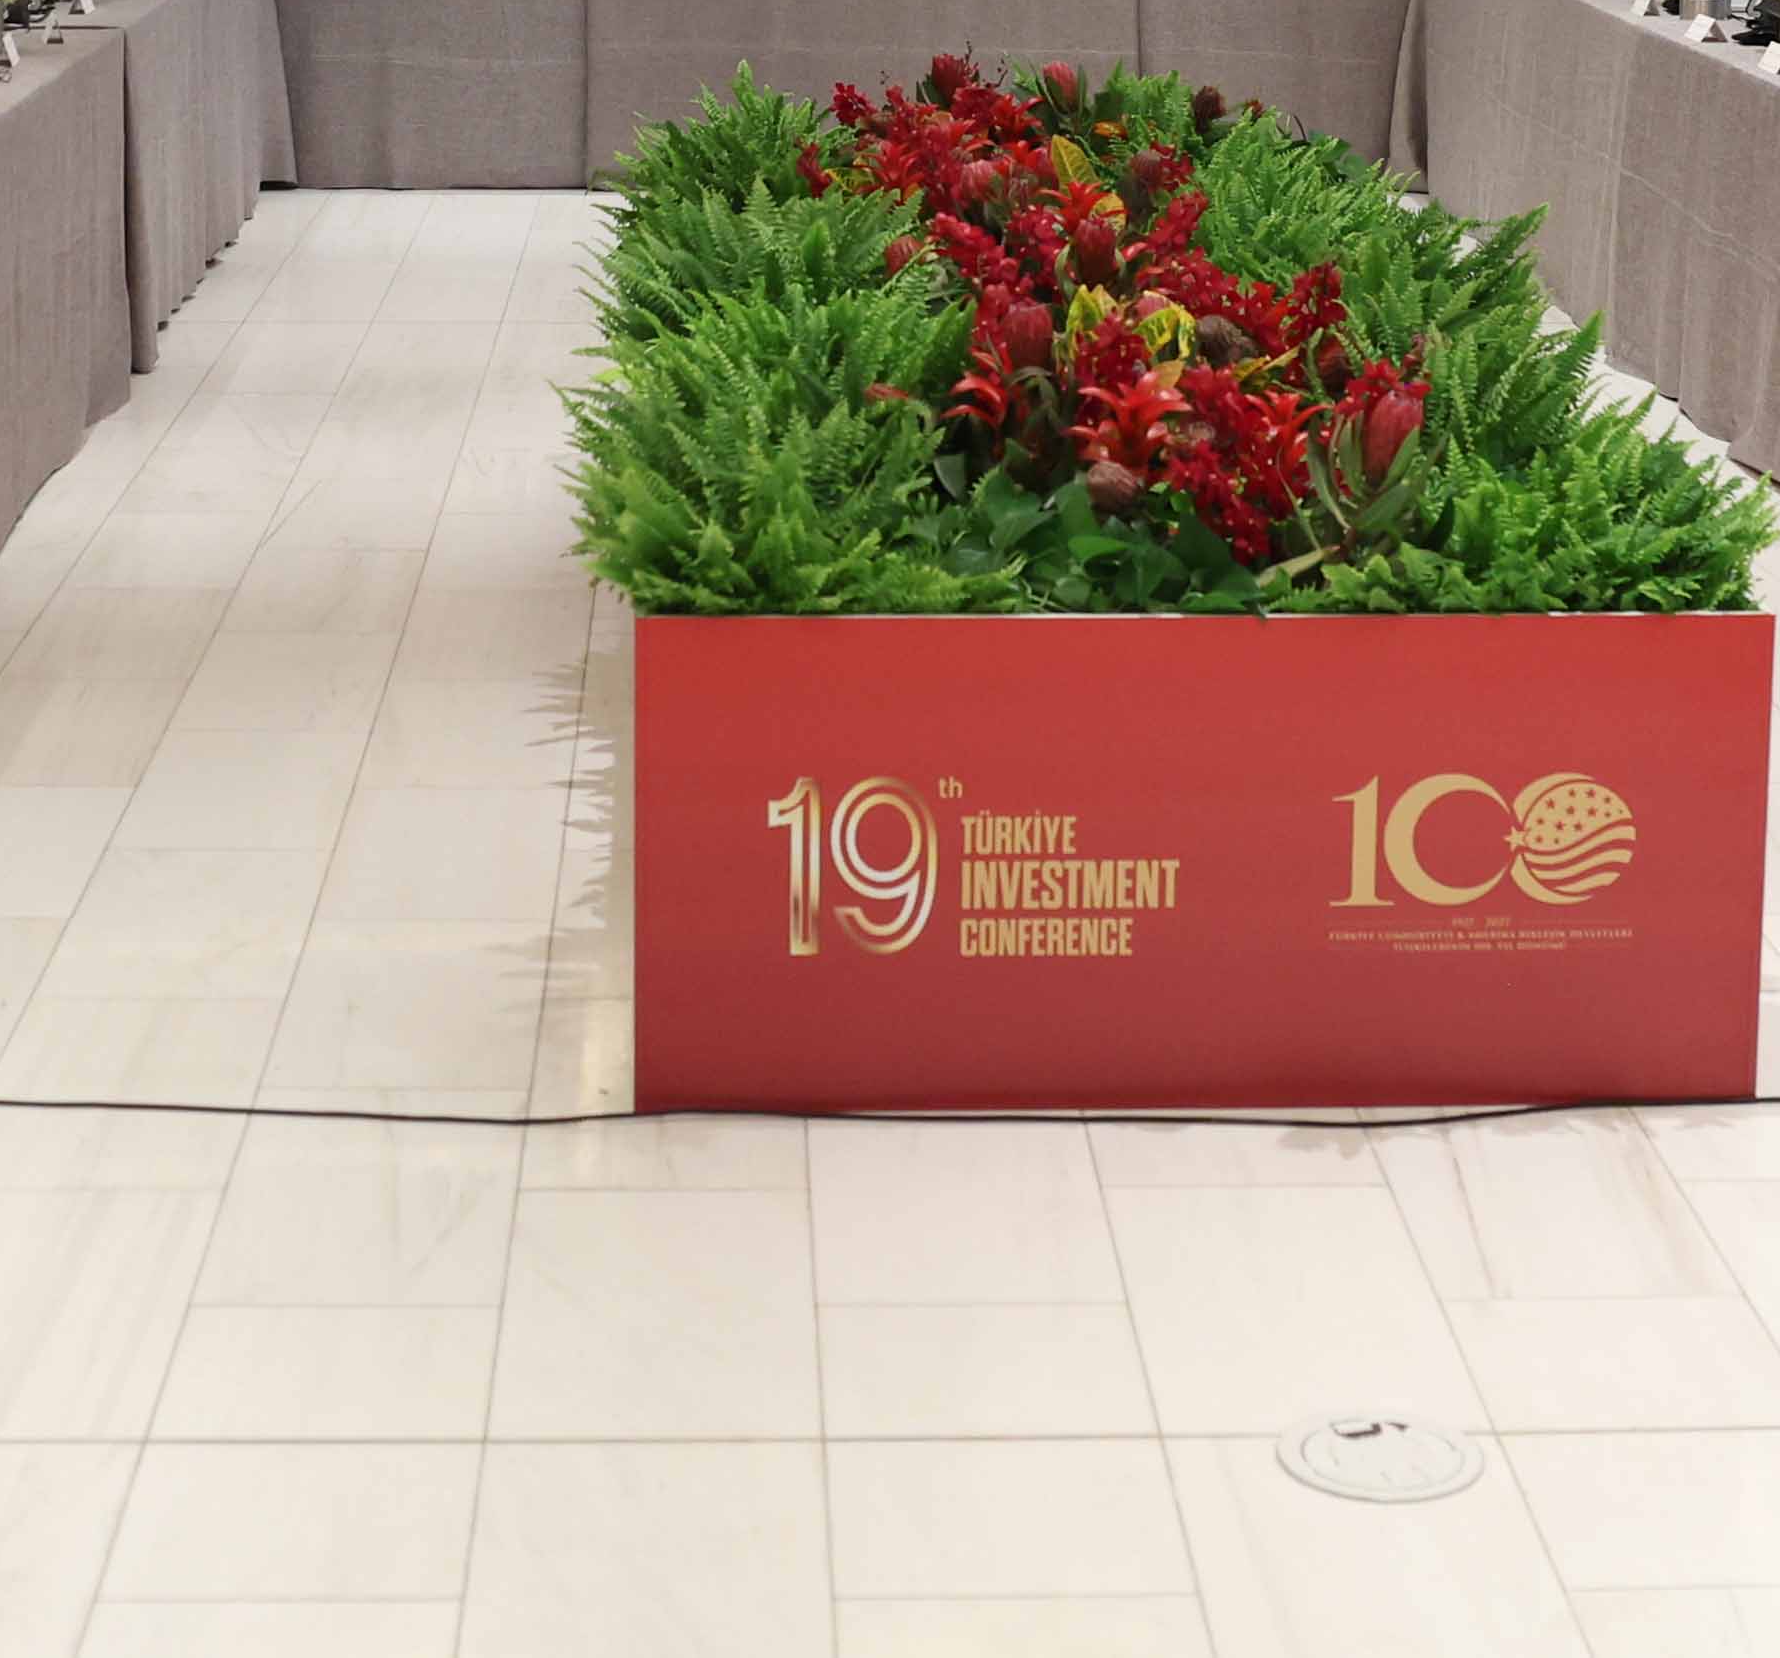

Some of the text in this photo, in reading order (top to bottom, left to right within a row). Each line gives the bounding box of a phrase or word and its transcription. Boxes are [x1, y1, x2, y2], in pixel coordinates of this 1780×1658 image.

[960, 810, 1077, 855] TÜRKİYE
[960, 859, 1180, 909] INVESTMENT
[960, 917, 1133, 956] CONFERENCE
